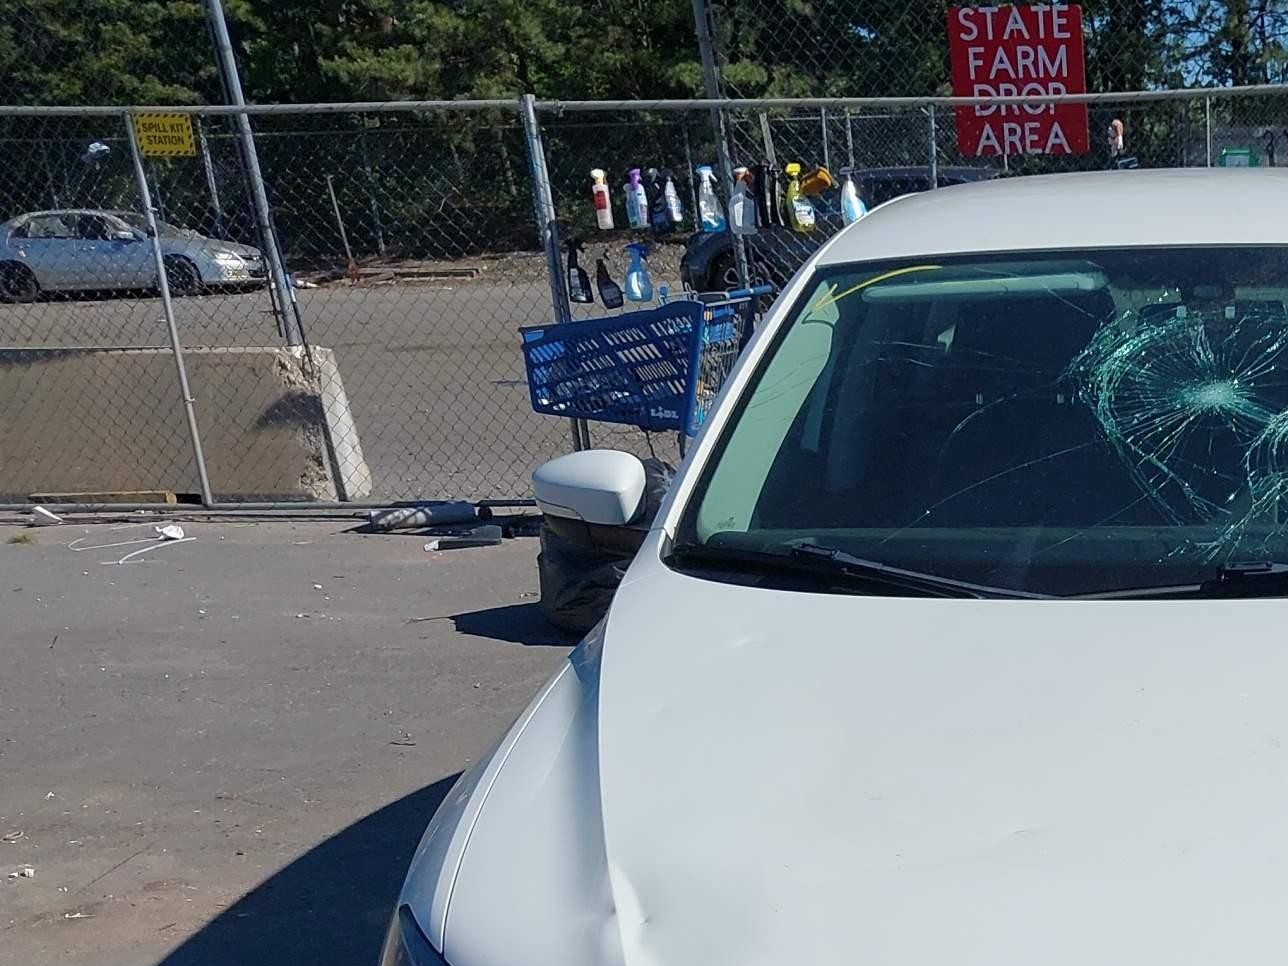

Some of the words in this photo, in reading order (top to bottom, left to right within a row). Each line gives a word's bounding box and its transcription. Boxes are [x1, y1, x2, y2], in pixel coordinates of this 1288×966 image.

[958, 4, 1071, 41] STATE
[968, 44, 1068, 80] FARM
[973, 82, 1067, 117] DROP
[142, 122, 168, 133] SPILL
[170, 123, 184, 133] KIT
[146, 135, 185, 146] STATION
[976, 122, 1072, 156] AREA
